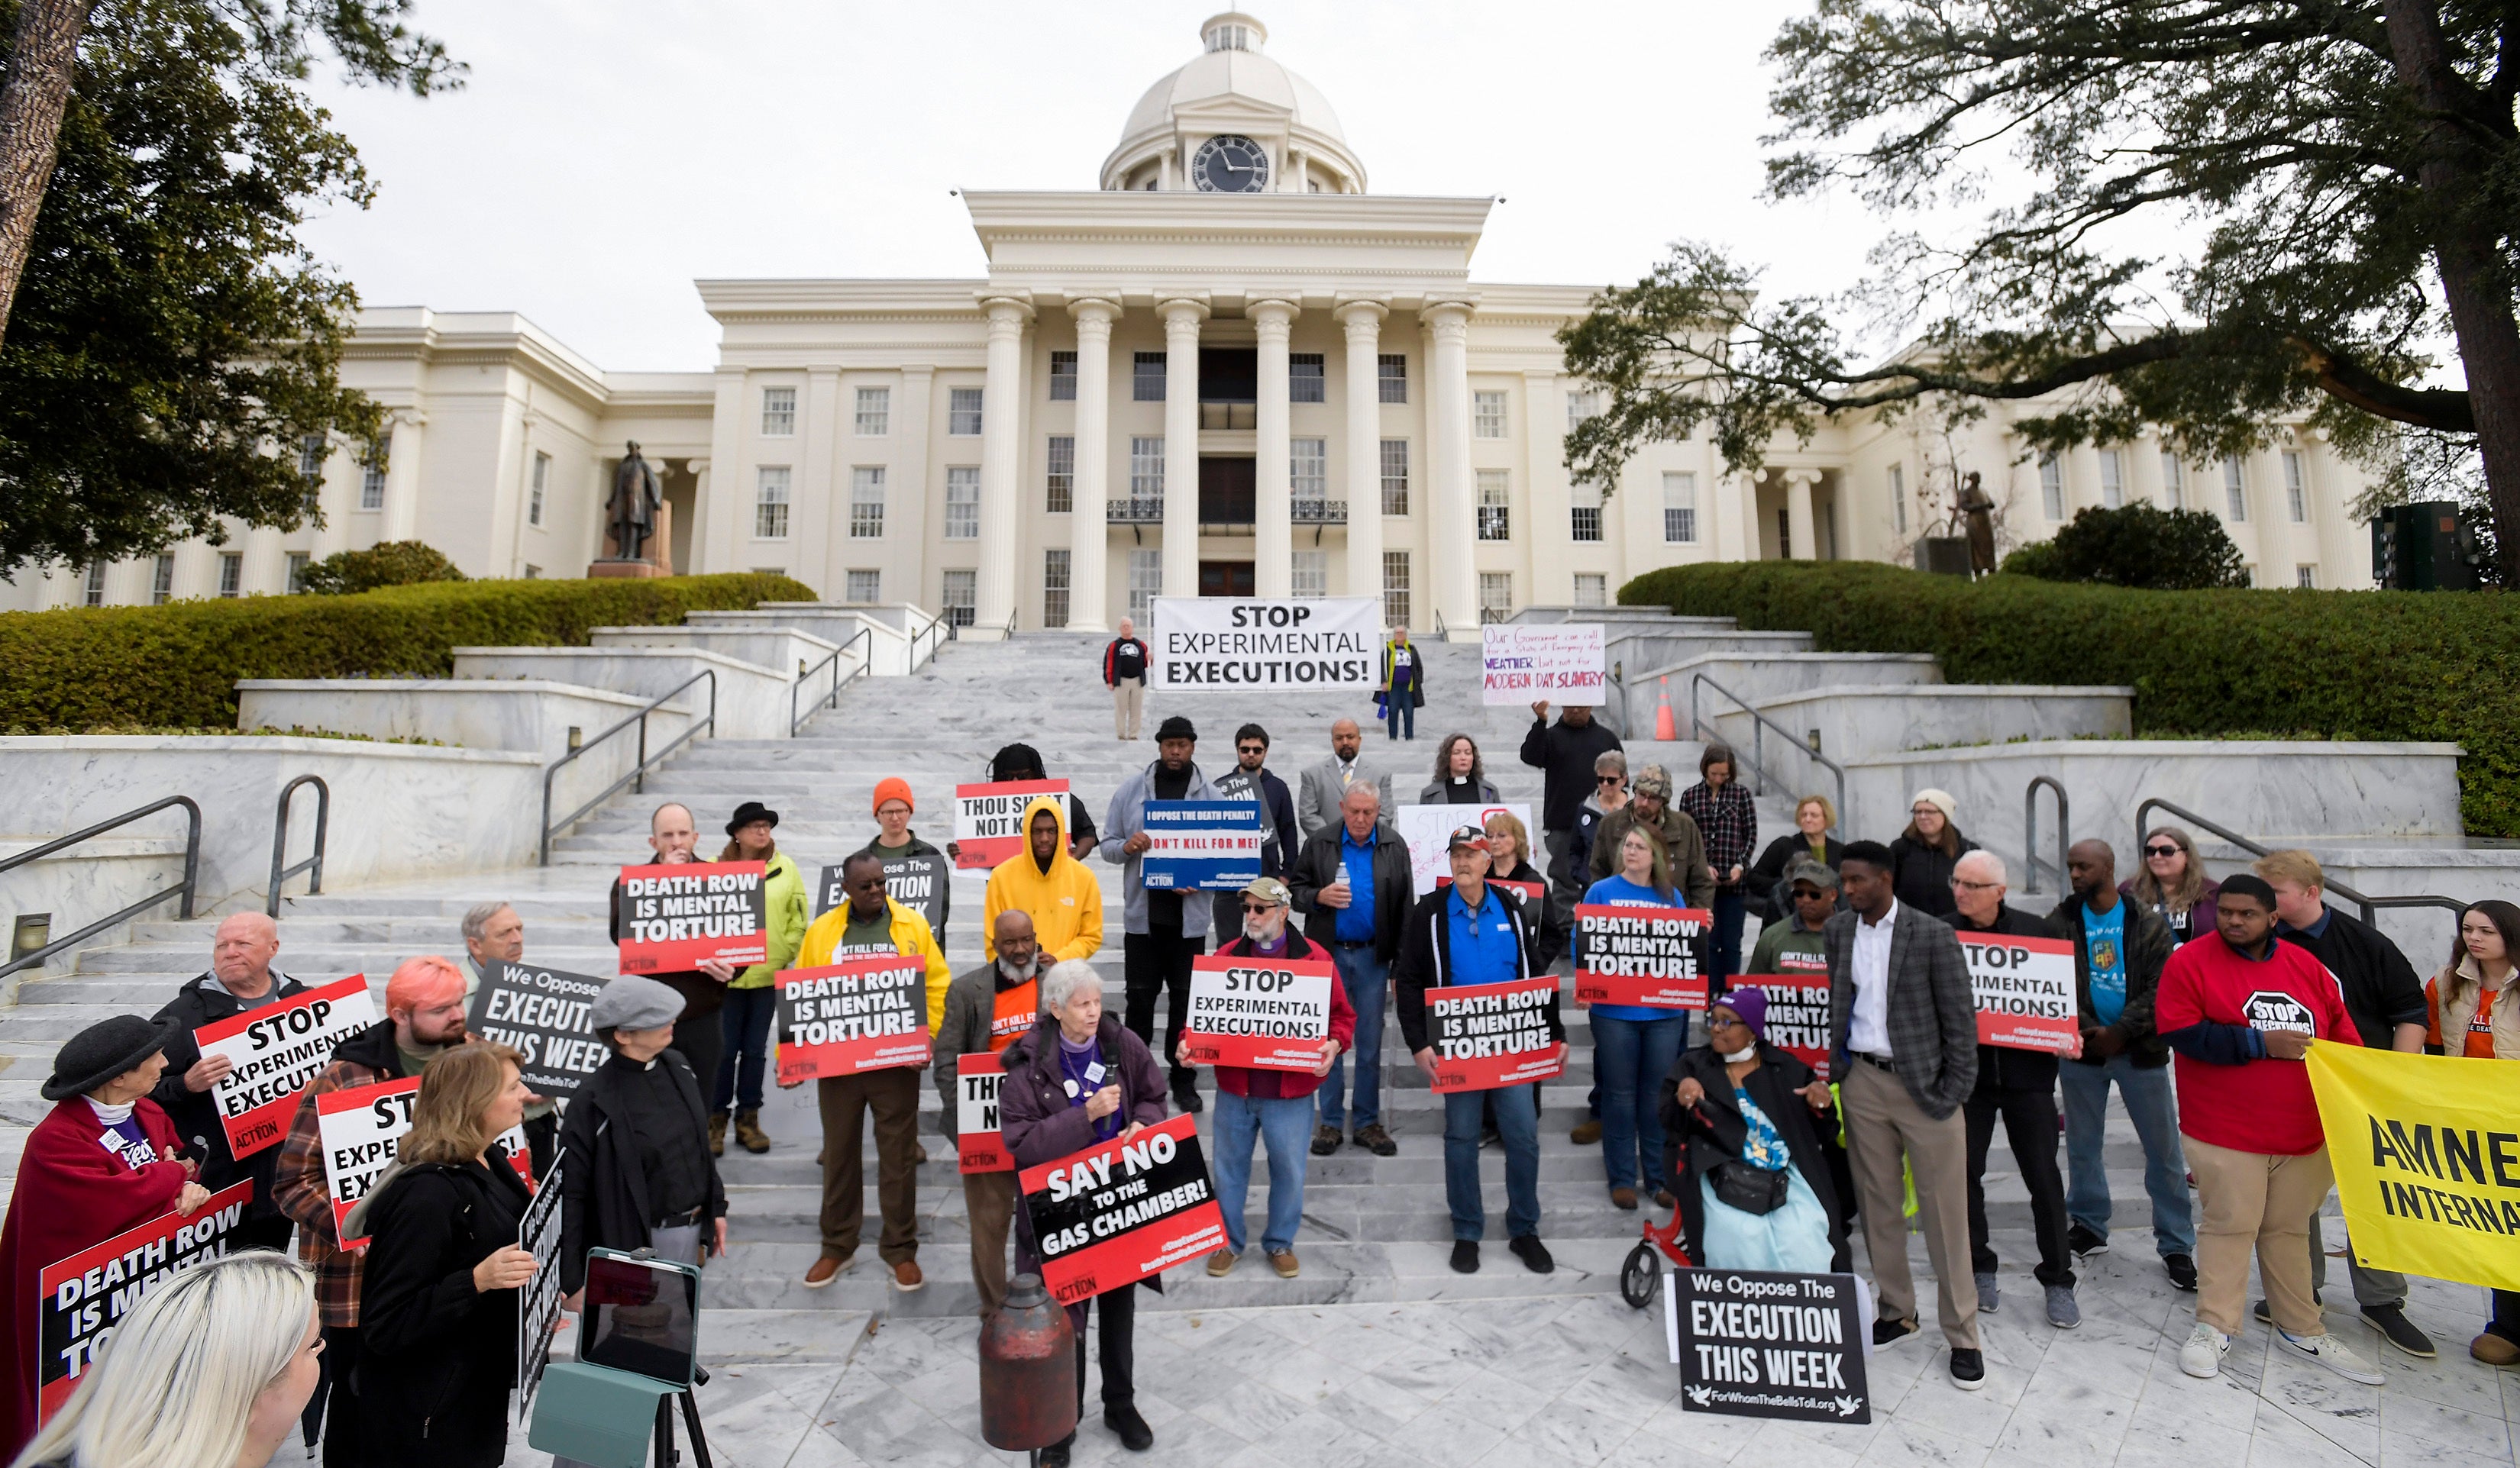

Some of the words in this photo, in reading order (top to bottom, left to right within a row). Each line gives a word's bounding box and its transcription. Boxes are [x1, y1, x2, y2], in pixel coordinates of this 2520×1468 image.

[1232, 606, 1310, 627] STOP
[1169, 633, 1367, 653] EXPERIMENTAL
[1485, 627, 1508, 644] Our
[1168, 660, 1369, 682] EXECUTIONS!
[1557, 671, 1605, 689] SLAVERY
[1229, 776, 1249, 789] The
[962, 797, 1006, 816] THOU
[1012, 795, 1063, 813] SHT
[1147, 811, 1151, 821] I
[1152, 811, 1181, 821] OPPOSE
[1181, 811, 1197, 821] THE
[1197, 811, 1222, 821] DEATH
[1223, 810, 1255, 820] PENALTY
[976, 818, 1008, 836] NOT
[1151, 837, 1178, 849] ON'T
[1184, 837, 1207, 849] KILL
[1212, 837, 1233, 849] FOR
[1238, 837, 1258, 849] ME!
[834, 867, 844, 879] W
[884, 865, 905, 874] ose
[908, 860, 932, 872] The
[1145, 876, 1173, 886] ACTION
[627, 876, 702, 897] DEATH
[707, 873, 758, 893] ROW
[828, 876, 932, 905] EXTION
[635, 899, 657, 918] IS
[662, 894, 751, 916] MENTAL
[630, 913, 756, 944] TORTURE
[1581, 916, 1646, 935] DEATH
[1652, 918, 1700, 937] ROW
[842, 944, 854, 954] N'T
[855, 944, 871, 953] KILL
[873, 943, 888, 953] FOR
[1589, 935, 1607, 953] IS
[1611, 936, 1693, 957] MENTAL
[1780, 951, 1801, 961] DON'T
[1801, 953, 1817, 963] KILL
[1965, 945, 2028, 969] TOP
[1584, 953, 1698, 979] TORTURE
[503, 965, 531, 986] We
[535, 972, 601, 997] Oppose
[786, 974, 858, 1001] DEATH
[864, 967, 916, 991] ROW
[1226, 969, 1293, 993] STOP
[1969, 975, 2067, 995] IMENTAL
[794, 1002, 816, 1021] IS
[820, 989, 910, 1018] MENTAL
[1195, 997, 1321, 1017] EXPERIMENTAL
[1434, 995, 1502, 1017] DEATH
[1507, 987, 1552, 1011] ROW
[1802, 986, 1830, 1005] RO
[1975, 995, 2067, 1018] UTIONS!
[486, 988, 593, 1034] EXECUTI
[991, 1018, 1008, 1031] ON'T
[1009, 1014, 1026, 1025] KILL
[1026, 1012, 1036, 1022] FO
[1443, 1018, 1462, 1037] IS
[1467, 1008, 1546, 1035] MENTAL
[1765, 1005, 1830, 1025] MENTA
[2253, 1000, 2299, 1021] STOP
[2473, 1015, 2486, 1024] LL
[247, 1001, 331, 1050] STOP
[789, 1010, 916, 1047] TORTURE
[1194, 1016, 1320, 1039] EXECUTIONS!
[1439, 1027, 1551, 1060] TORTURE
[225, 1062, 325, 1117] EXECUTI
[966, 1076, 1006, 1100] TH
[1436, 1074, 1466, 1087] CTION
[374, 1092, 417, 1129] ST
[235, 1121, 278, 1150] ACTION
[1047, 1152, 1111, 1202] SAY
[1121, 1133, 1176, 1176] NO
[1092, 1192, 1116, 1209] TO
[1116, 1179, 1148, 1202] THE
[1042, 1223, 1090, 1255] GAS
[1092, 1179, 1208, 1237] CHAMBER!
[2379, 1180, 2520, 1235] INTERNA
[57, 1235, 166, 1312] DEATH
[176, 1200, 243, 1254] ROW
[1055, 1277, 1097, 1301] ACTION
[1691, 1273, 1723, 1292] We
[1727, 1276, 1797, 1299] Oppose
[1800, 1279, 1835, 1299] The
[71, 1300, 102, 1339] IS
[1691, 1300, 1843, 1344] EXECUTION
[1695, 1344, 1759, 1384] THIS
[1764, 1348, 1846, 1390] WEEK
[1711, 1390, 1835, 1412] ForWhomTheBellsToll.org
